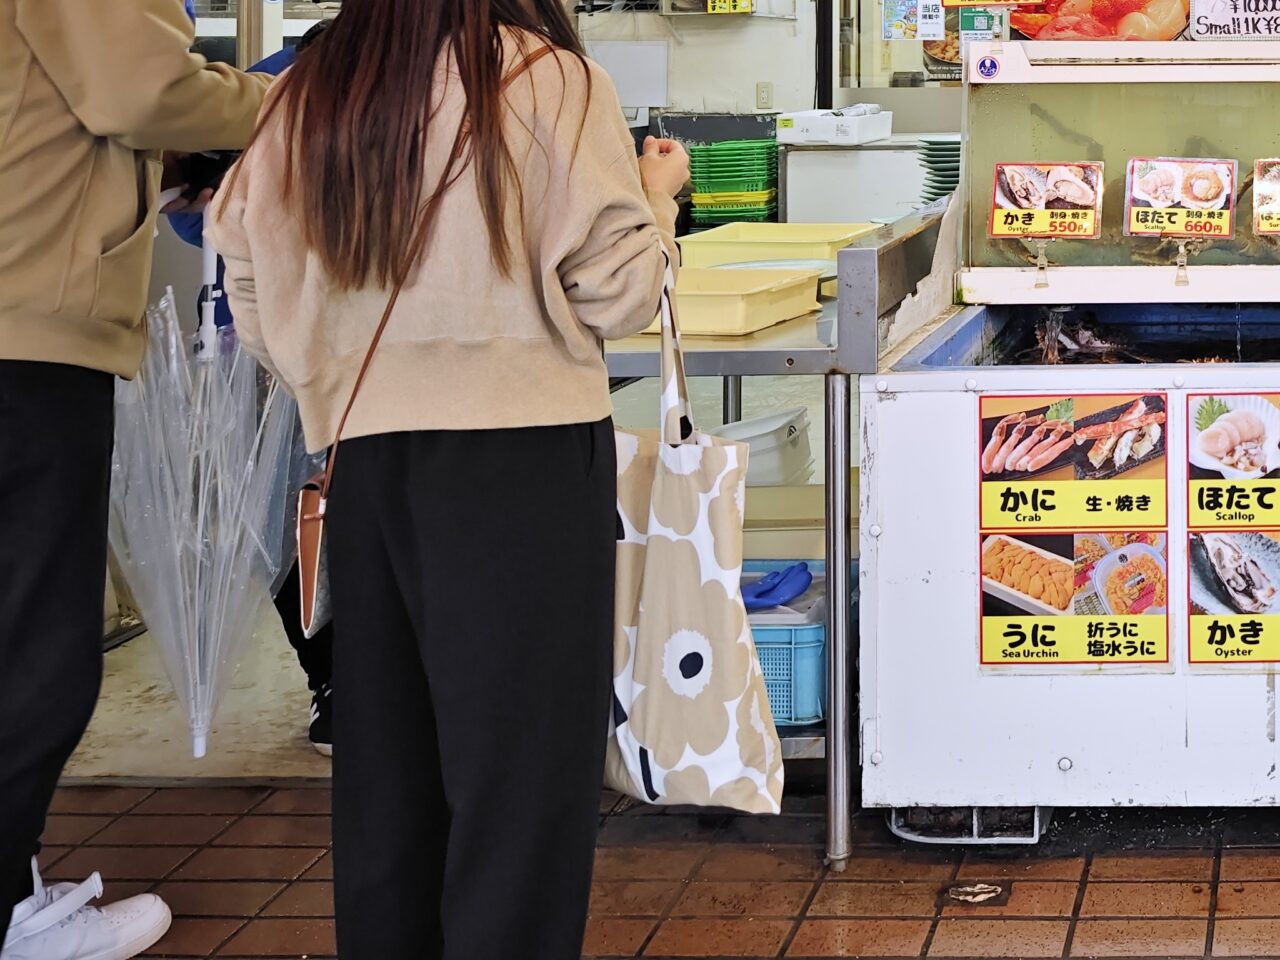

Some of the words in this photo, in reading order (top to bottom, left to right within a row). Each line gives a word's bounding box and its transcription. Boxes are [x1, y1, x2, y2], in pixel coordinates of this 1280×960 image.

[921, 4, 940, 13] 当店
[1196, 15, 1241, 36] Small
[1003, 211, 1035, 225] かき
[1136, 210, 1178, 224] ほたて
[1184, 221, 1222, 233] 660円
[1000, 487, 1056, 512] かに
[1198, 485, 1276, 511] ほたて
[1015, 513, 1042, 522] Crab
[1215, 511, 1255, 522] Scallop
[1002, 623, 1056, 649] うに
[1087, 622, 1139, 639] 折うに
[1207, 620, 1264, 645] かき
[1001, 648, 1021, 658] Sea
[1023, 648, 1059, 658] Urchin
[1087, 640, 1156, 657] 塩水うに
[1214, 647, 1253, 658] Oyster
